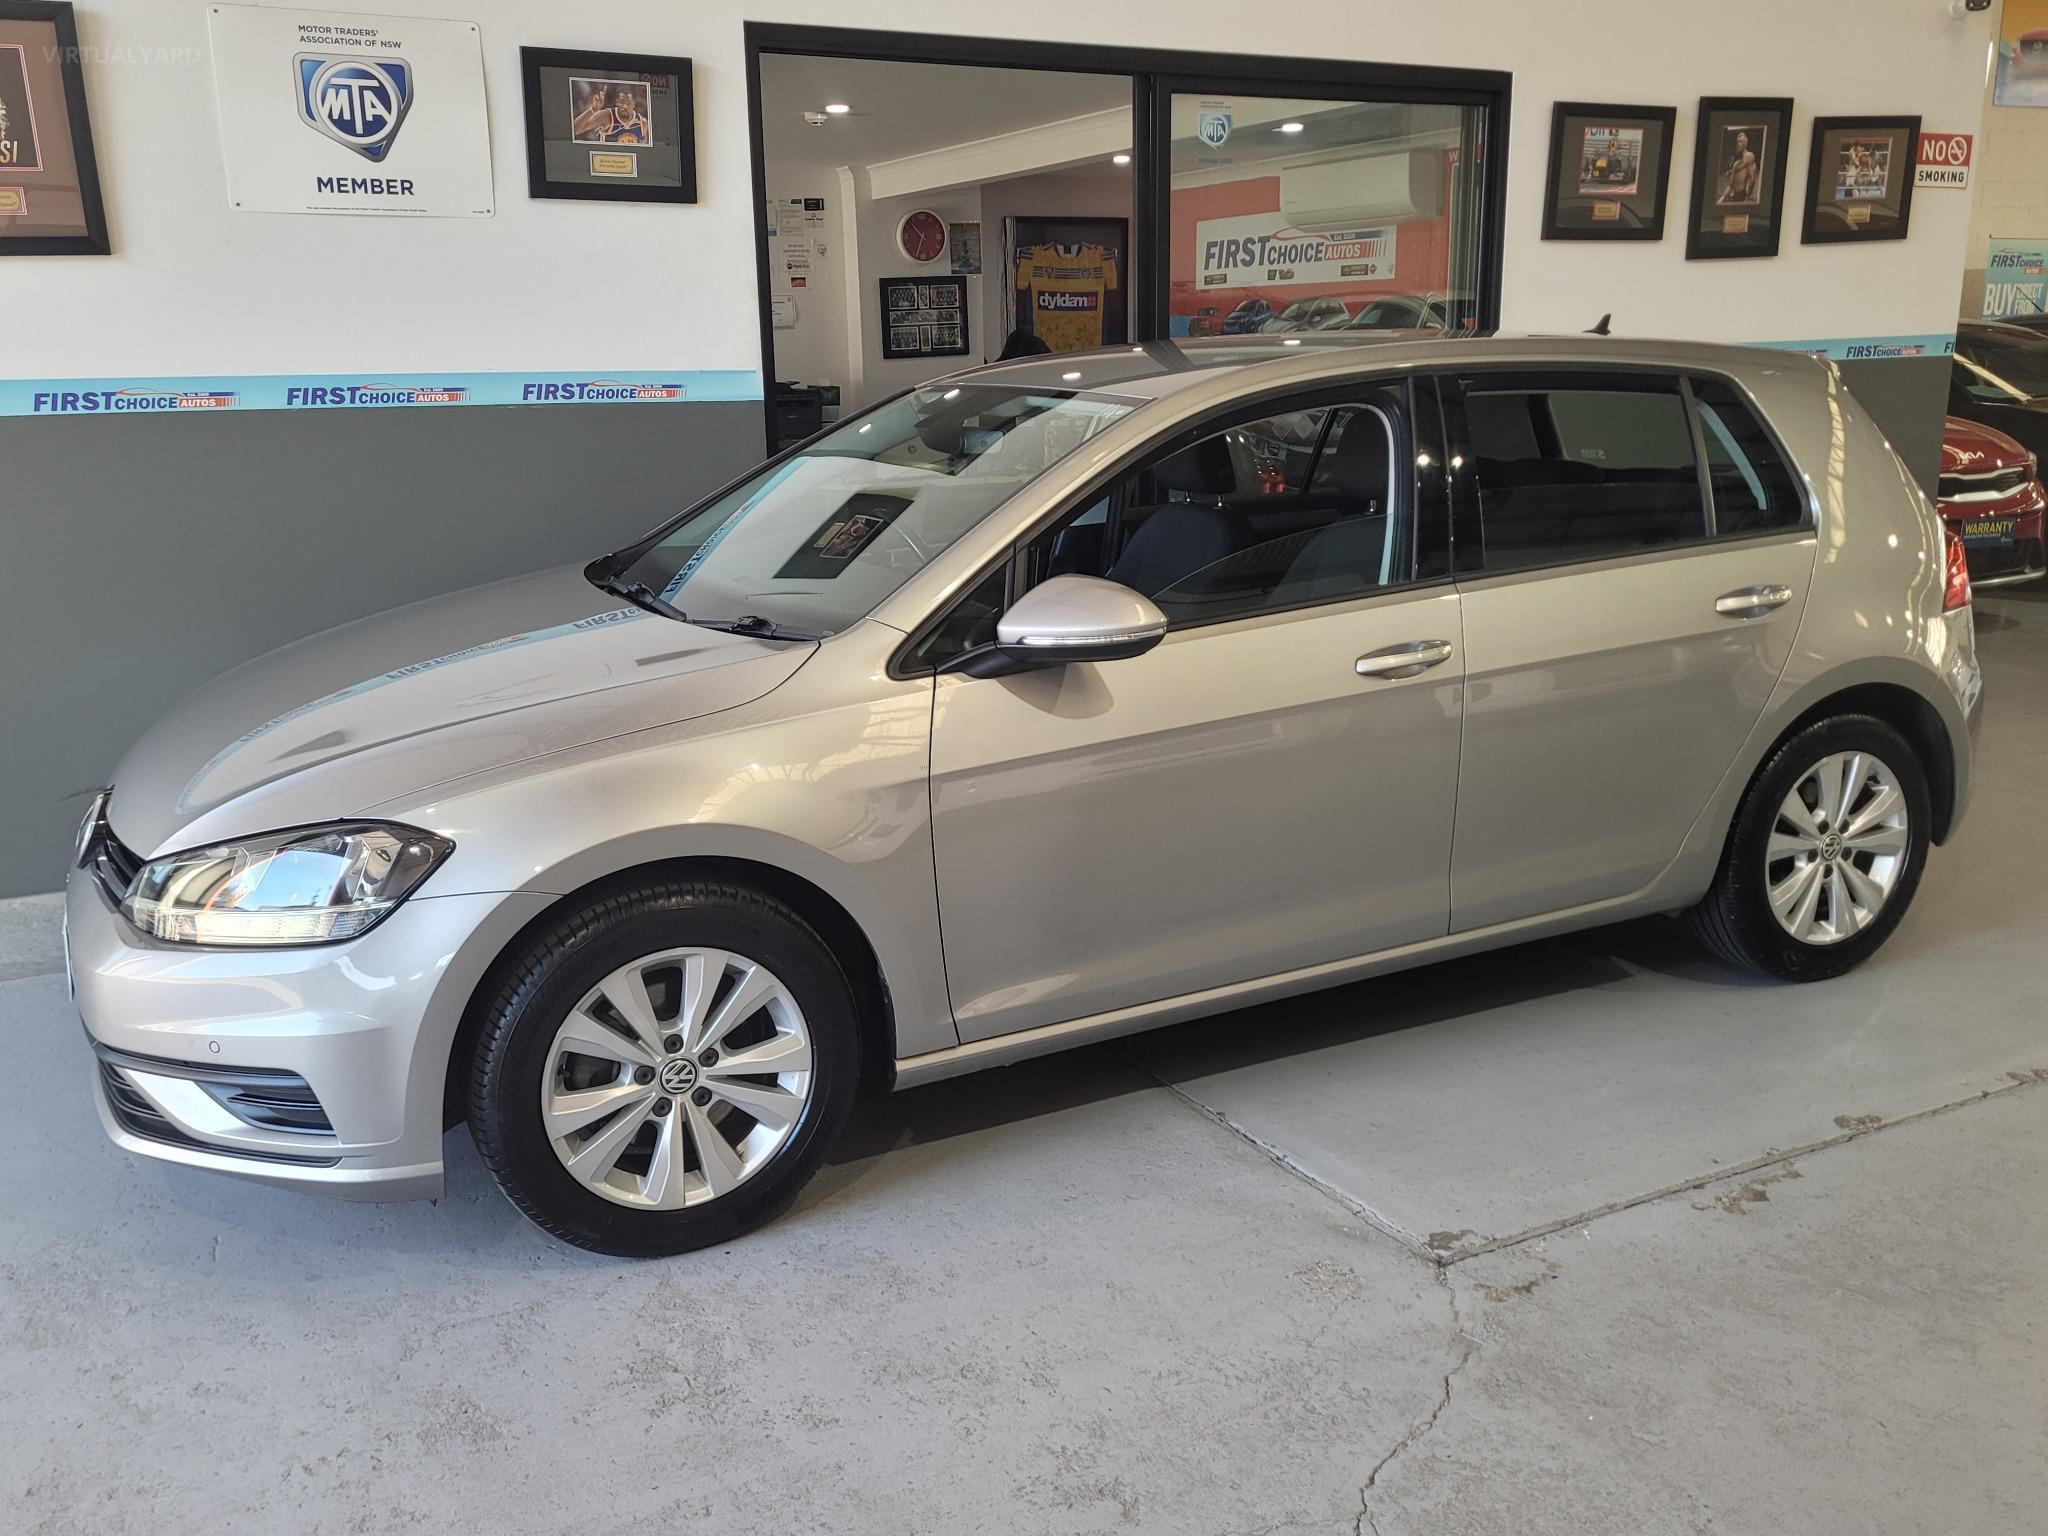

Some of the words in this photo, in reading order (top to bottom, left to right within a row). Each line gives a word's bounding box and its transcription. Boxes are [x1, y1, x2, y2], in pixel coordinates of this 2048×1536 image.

[298, 25, 332, 34] MOTOR
[334, 27, 378, 36] TRADERS'
[299, 35, 362, 46] ASSOCIATION
[321, 77, 391, 134] MTA
[1922, 139, 1947, 161] NO
[1918, 170, 1964, 183] SMOKING
[317, 176, 415, 196] MEMBER
[1203, 235, 1271, 271] FIRST
[1267, 241, 1325, 266] CHOICE
[1325, 244, 1361, 260] AUTOS
[1990, 254, 2022, 268] FIRST
[1039, 292, 1088, 309] dyldam
[1983, 283, 2018, 316] BUY
[1846, 345, 1879, 358] FIRST
[286, 386, 361, 406] FIRST
[358, 392, 416, 404] CHOICE
[417, 393, 450, 402] AUTOS
[522, 383, 588, 401] FIRST
[586, 388, 637, 400] CHOICE
[638, 390, 668, 399] AUTOS
[34, 391, 117, 412] FIRST
[114, 397, 177, 410] CHOICE
[180, 398, 217, 408] AUTOS
[1964, 520, 2014, 535] WARRANTY
